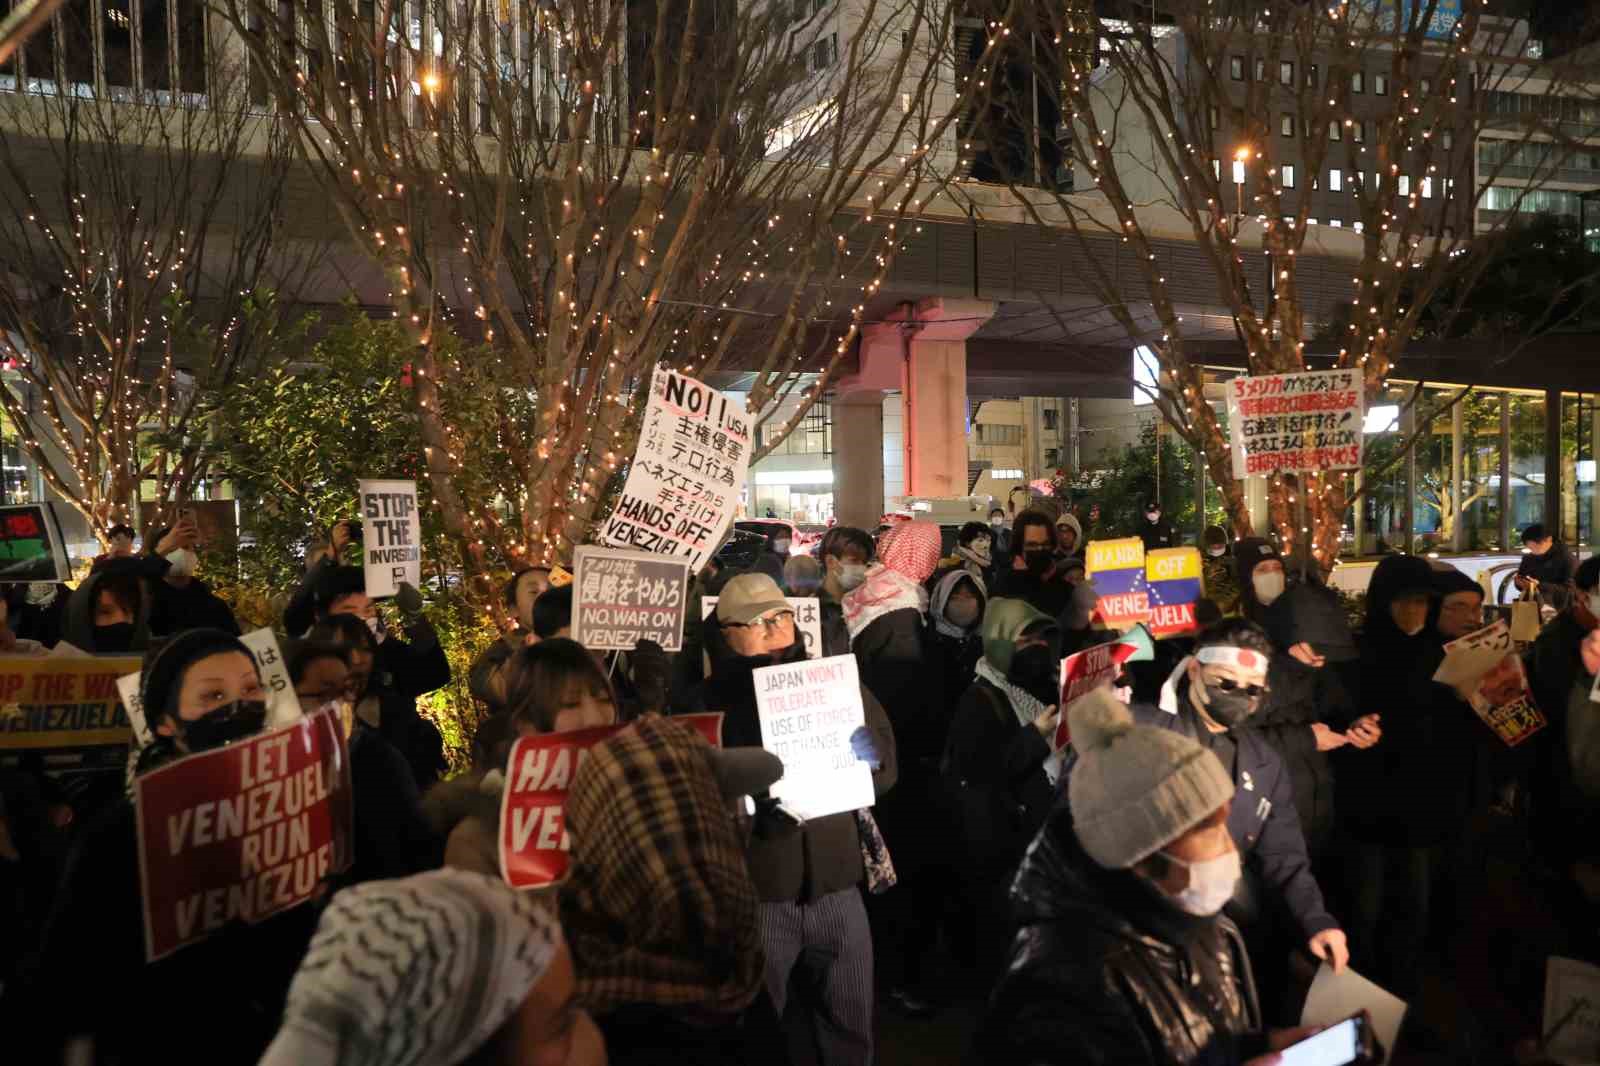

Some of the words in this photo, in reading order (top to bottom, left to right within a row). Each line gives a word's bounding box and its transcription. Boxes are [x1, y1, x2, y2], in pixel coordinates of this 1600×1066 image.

[665, 374, 727, 427] NO!!
[728, 415, 748, 439] USA
[675, 416, 743, 461] 主権侵害
[672, 441, 735, 487] テロ行為
[364, 493, 414, 518] STOP
[616, 494, 676, 533] HANDS
[675, 519, 712, 545] OFF
[373, 520, 412, 546] THE
[584, 559, 637, 575] アメリカは
[1155, 556, 1185, 577] OFF
[581, 571, 680, 607] 侵略をやめろ
[583, 608, 609, 624] NO
[614, 610, 649, 627] WAR
[652, 611, 676, 628] ON
[32, 673, 77, 701] THE
[764, 671, 805, 692] JAPAN
[767, 688, 828, 714] TOLERATE
[770, 716, 795, 738] USE
[799, 713, 813, 732] OF
[816, 705, 857, 728] FORCE
[241, 734, 291, 789] LET
[241, 812, 309, 879] RUN
